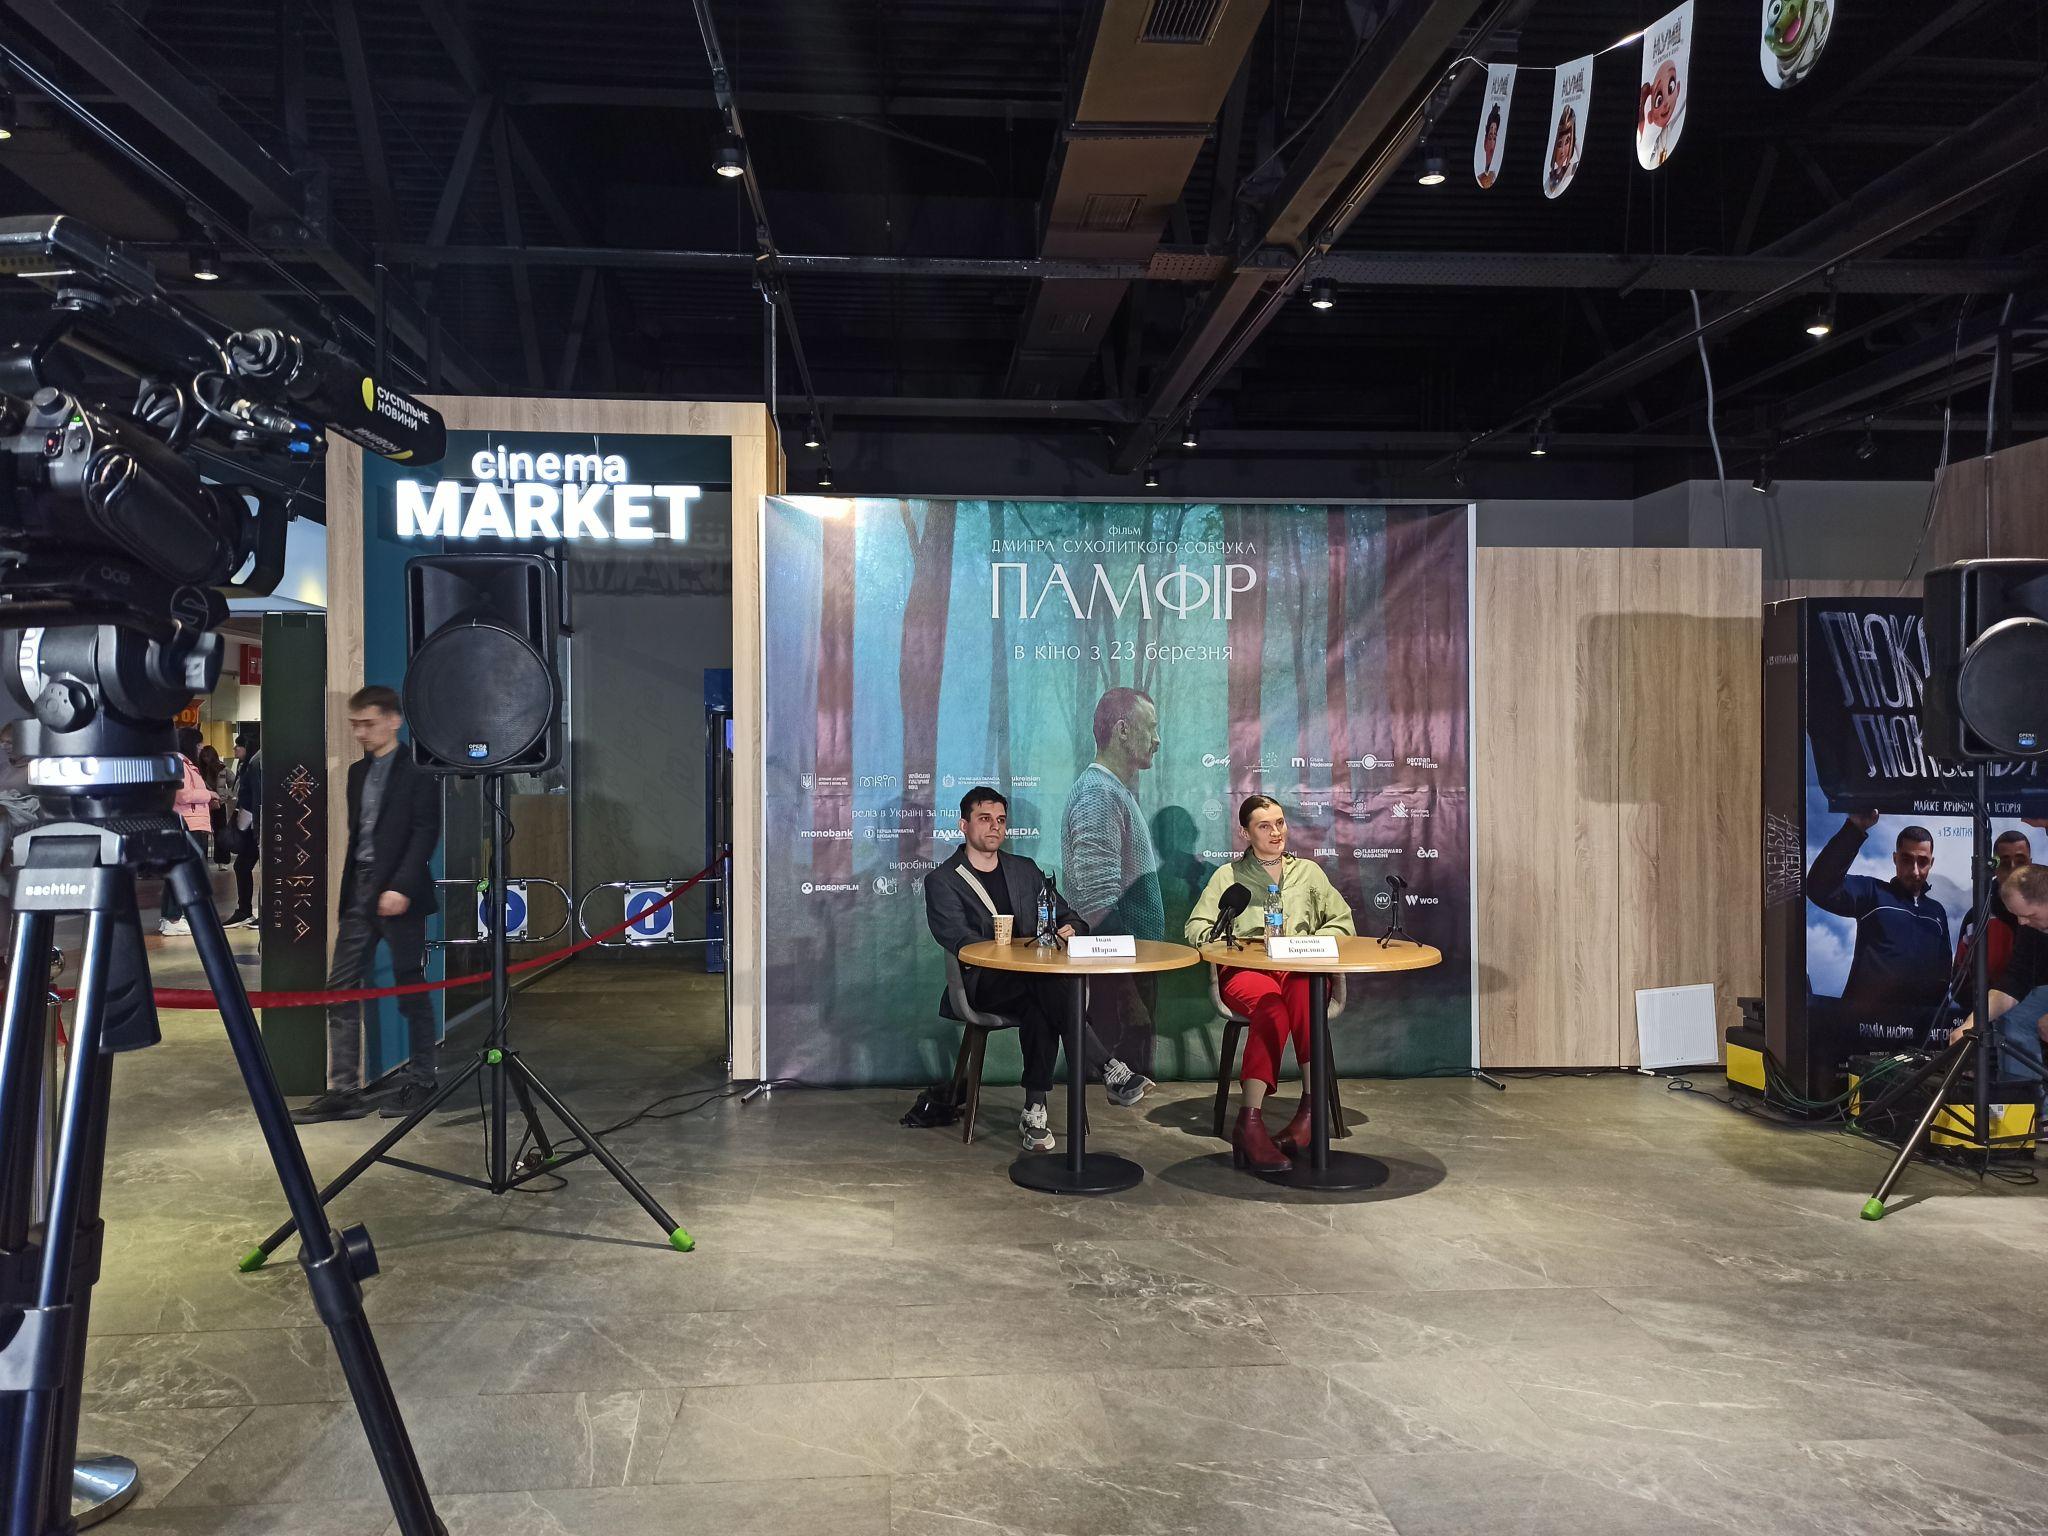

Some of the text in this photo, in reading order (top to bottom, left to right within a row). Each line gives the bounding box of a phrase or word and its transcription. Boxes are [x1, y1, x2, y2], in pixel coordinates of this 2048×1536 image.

[376, 385, 430, 425] СУСПІЛЬНЕ
[377, 400, 418, 431] НОВИНИ
[471, 445, 628, 482] cinema
[396, 480, 702, 540] MARKET
[1108, 524, 1141, 536] фільм
[991, 539, 1257, 555] ДМИТРА СУХОЛИТКОГО-СОБЧУКА
[991, 562, 1257, 620] ПАМФІР
[1035, 641, 1081, 660] кіно
[1111, 641, 1136, 661] 23
[1145, 641, 1233, 664] березня
[1913, 800, 1940, 812] МАЙЖЕ
[1994, 802, 2021, 813] ІСТОРІЯ
[801, 829, 852, 838] monobank
[1417, 847, 1438, 858] èva
[25, 882, 86, 896] sachtler
